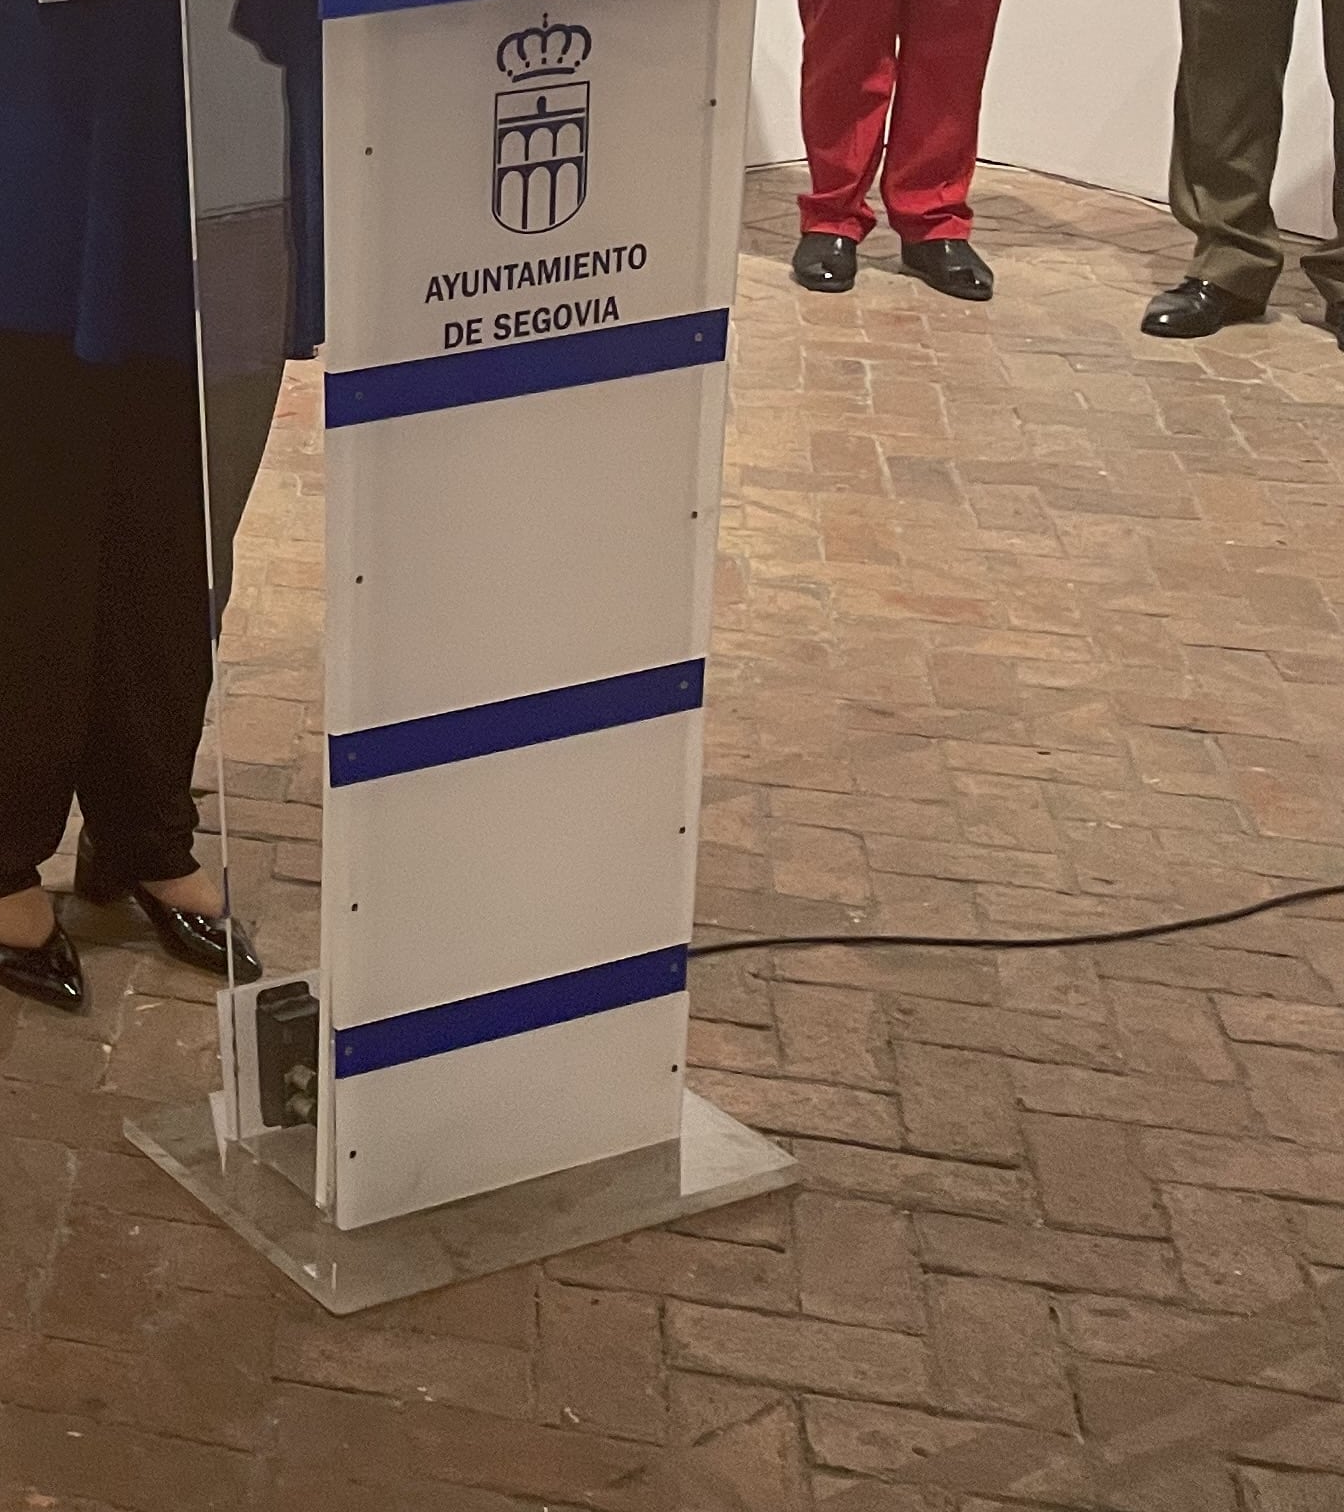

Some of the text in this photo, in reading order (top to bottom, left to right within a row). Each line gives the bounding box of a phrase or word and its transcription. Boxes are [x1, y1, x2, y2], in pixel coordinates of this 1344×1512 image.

[425, 241, 648, 304] AYUNTAMIENTO
[443, 295, 620, 350] DE SEGOVIA
